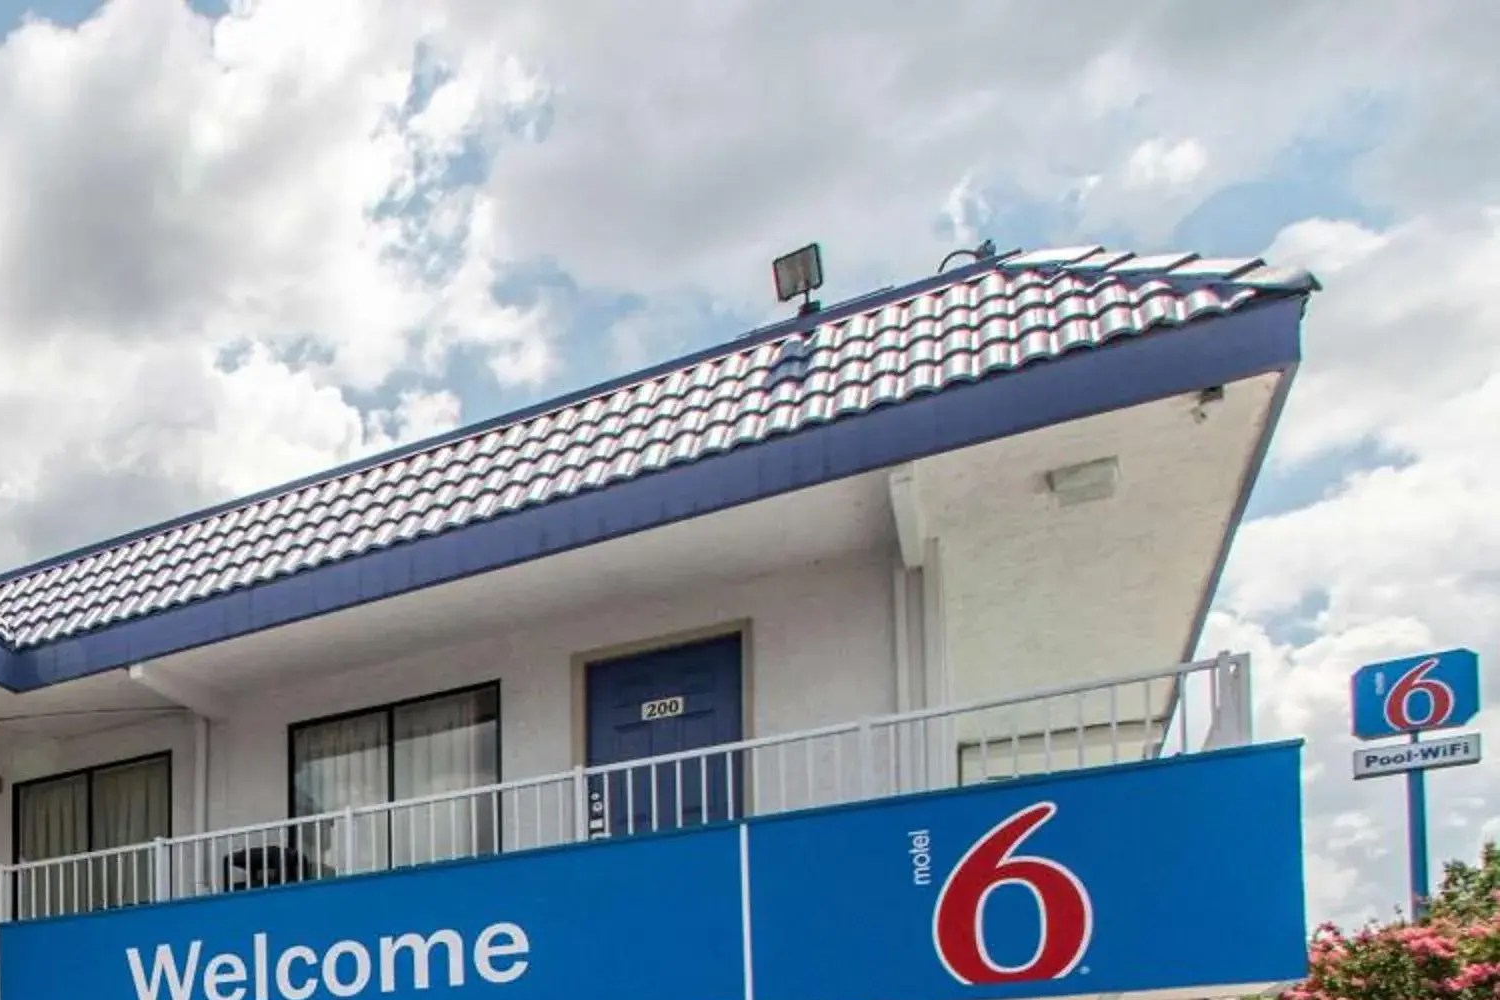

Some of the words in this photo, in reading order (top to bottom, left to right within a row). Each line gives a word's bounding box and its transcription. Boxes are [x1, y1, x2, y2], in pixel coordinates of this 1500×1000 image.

[646, 699, 680, 718] 200
[1384, 657, 1455, 731] 6
[907, 828, 932, 886] motel
[931, 800, 1094, 986] 6
